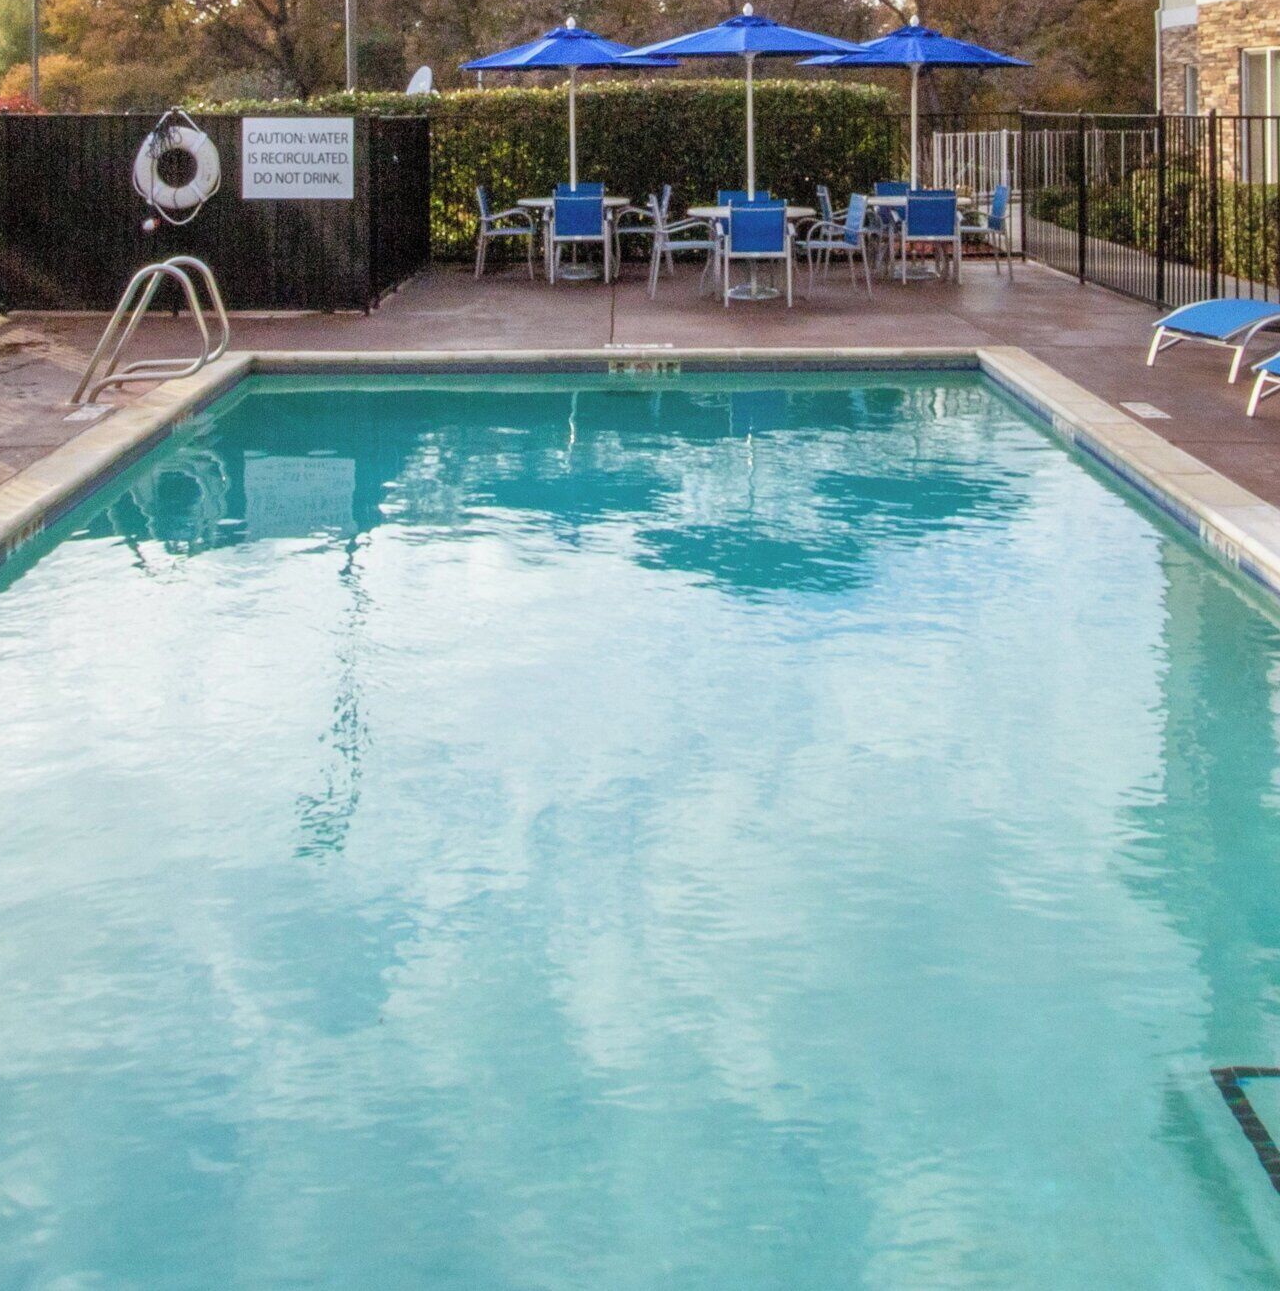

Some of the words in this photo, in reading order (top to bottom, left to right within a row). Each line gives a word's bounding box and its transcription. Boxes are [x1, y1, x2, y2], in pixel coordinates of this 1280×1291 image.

[248, 132, 306, 144] CAUTION:
[308, 132, 348, 144] WATER
[248, 152, 258, 164] IS
[261, 152, 349, 164] RECIRCULATED.
[253, 172, 272, 185] DO
[275, 172, 300, 185] NOT
[303, 172, 342, 185] DRINK.
